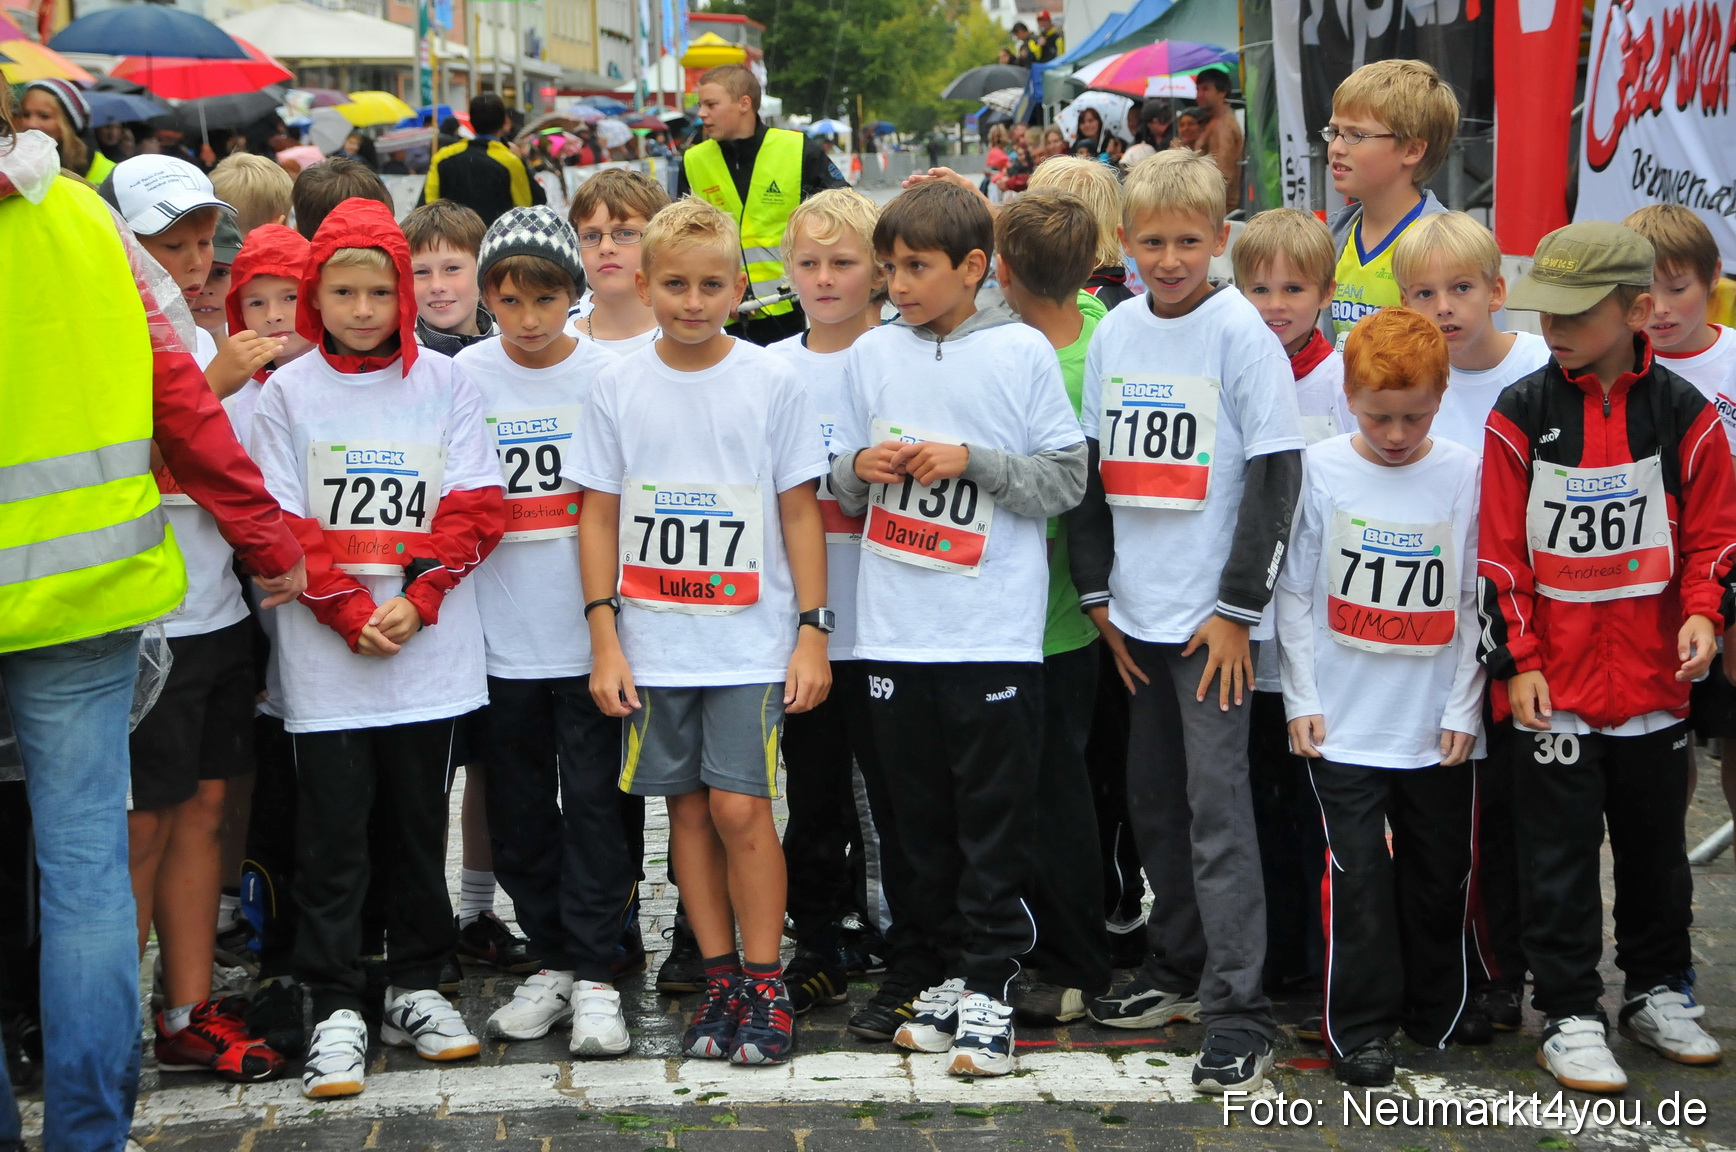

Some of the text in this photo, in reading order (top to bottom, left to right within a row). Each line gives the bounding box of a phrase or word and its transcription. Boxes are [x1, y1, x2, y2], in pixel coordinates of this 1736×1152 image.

[1336, 283, 1364, 299] EAM
[1122, 383, 1174, 398] BOCK
[497, 417, 558, 436] BOCK
[1106, 409, 1197, 460] 7180
[346, 450, 405, 465] BOCK
[496, 444, 563, 494] 29
[1566, 474, 1627, 492] BOCK
[323, 476, 427, 528] 7234
[655, 491, 717, 507] BOCK
[512, 503, 564, 520] Bastian
[977, 522, 986, 532] M
[1543, 495, 1648, 554] 7367
[634, 515, 746, 567] 7017
[885, 520, 940, 551] David
[1362, 528, 1423, 548] BOCK
[625, 553, 631, 562] 6
[749, 560, 757, 570] M
[1265, 540, 1285, 591] since
[1340, 548, 1445, 608] 7170
[1557, 564, 1622, 579] Andreas
[659, 576, 716, 599] Lukas
[1333, 603, 1433, 643] SIMON
[868, 675, 895, 700] 159
[985, 690, 1012, 701] JAKO
[1533, 732, 1580, 766] 30
